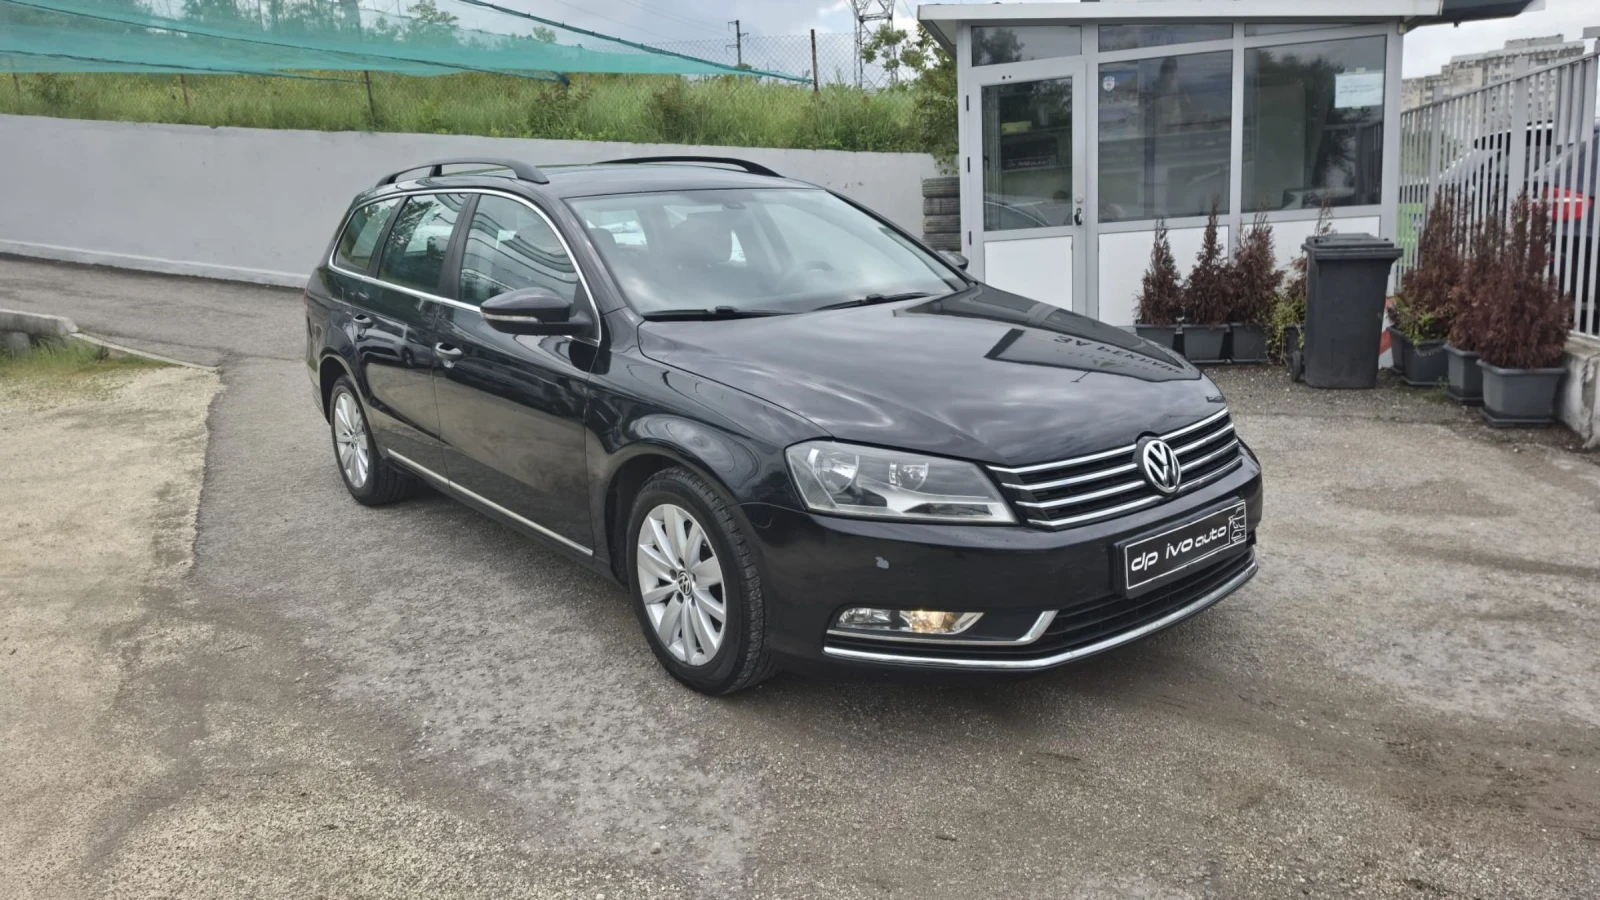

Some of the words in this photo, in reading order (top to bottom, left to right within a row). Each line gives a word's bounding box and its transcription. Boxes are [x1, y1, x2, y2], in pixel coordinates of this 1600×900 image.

[1131, 551, 1158, 571] dp
[1166, 538, 1193, 559] ivo
[1195, 526, 1227, 547] auto
